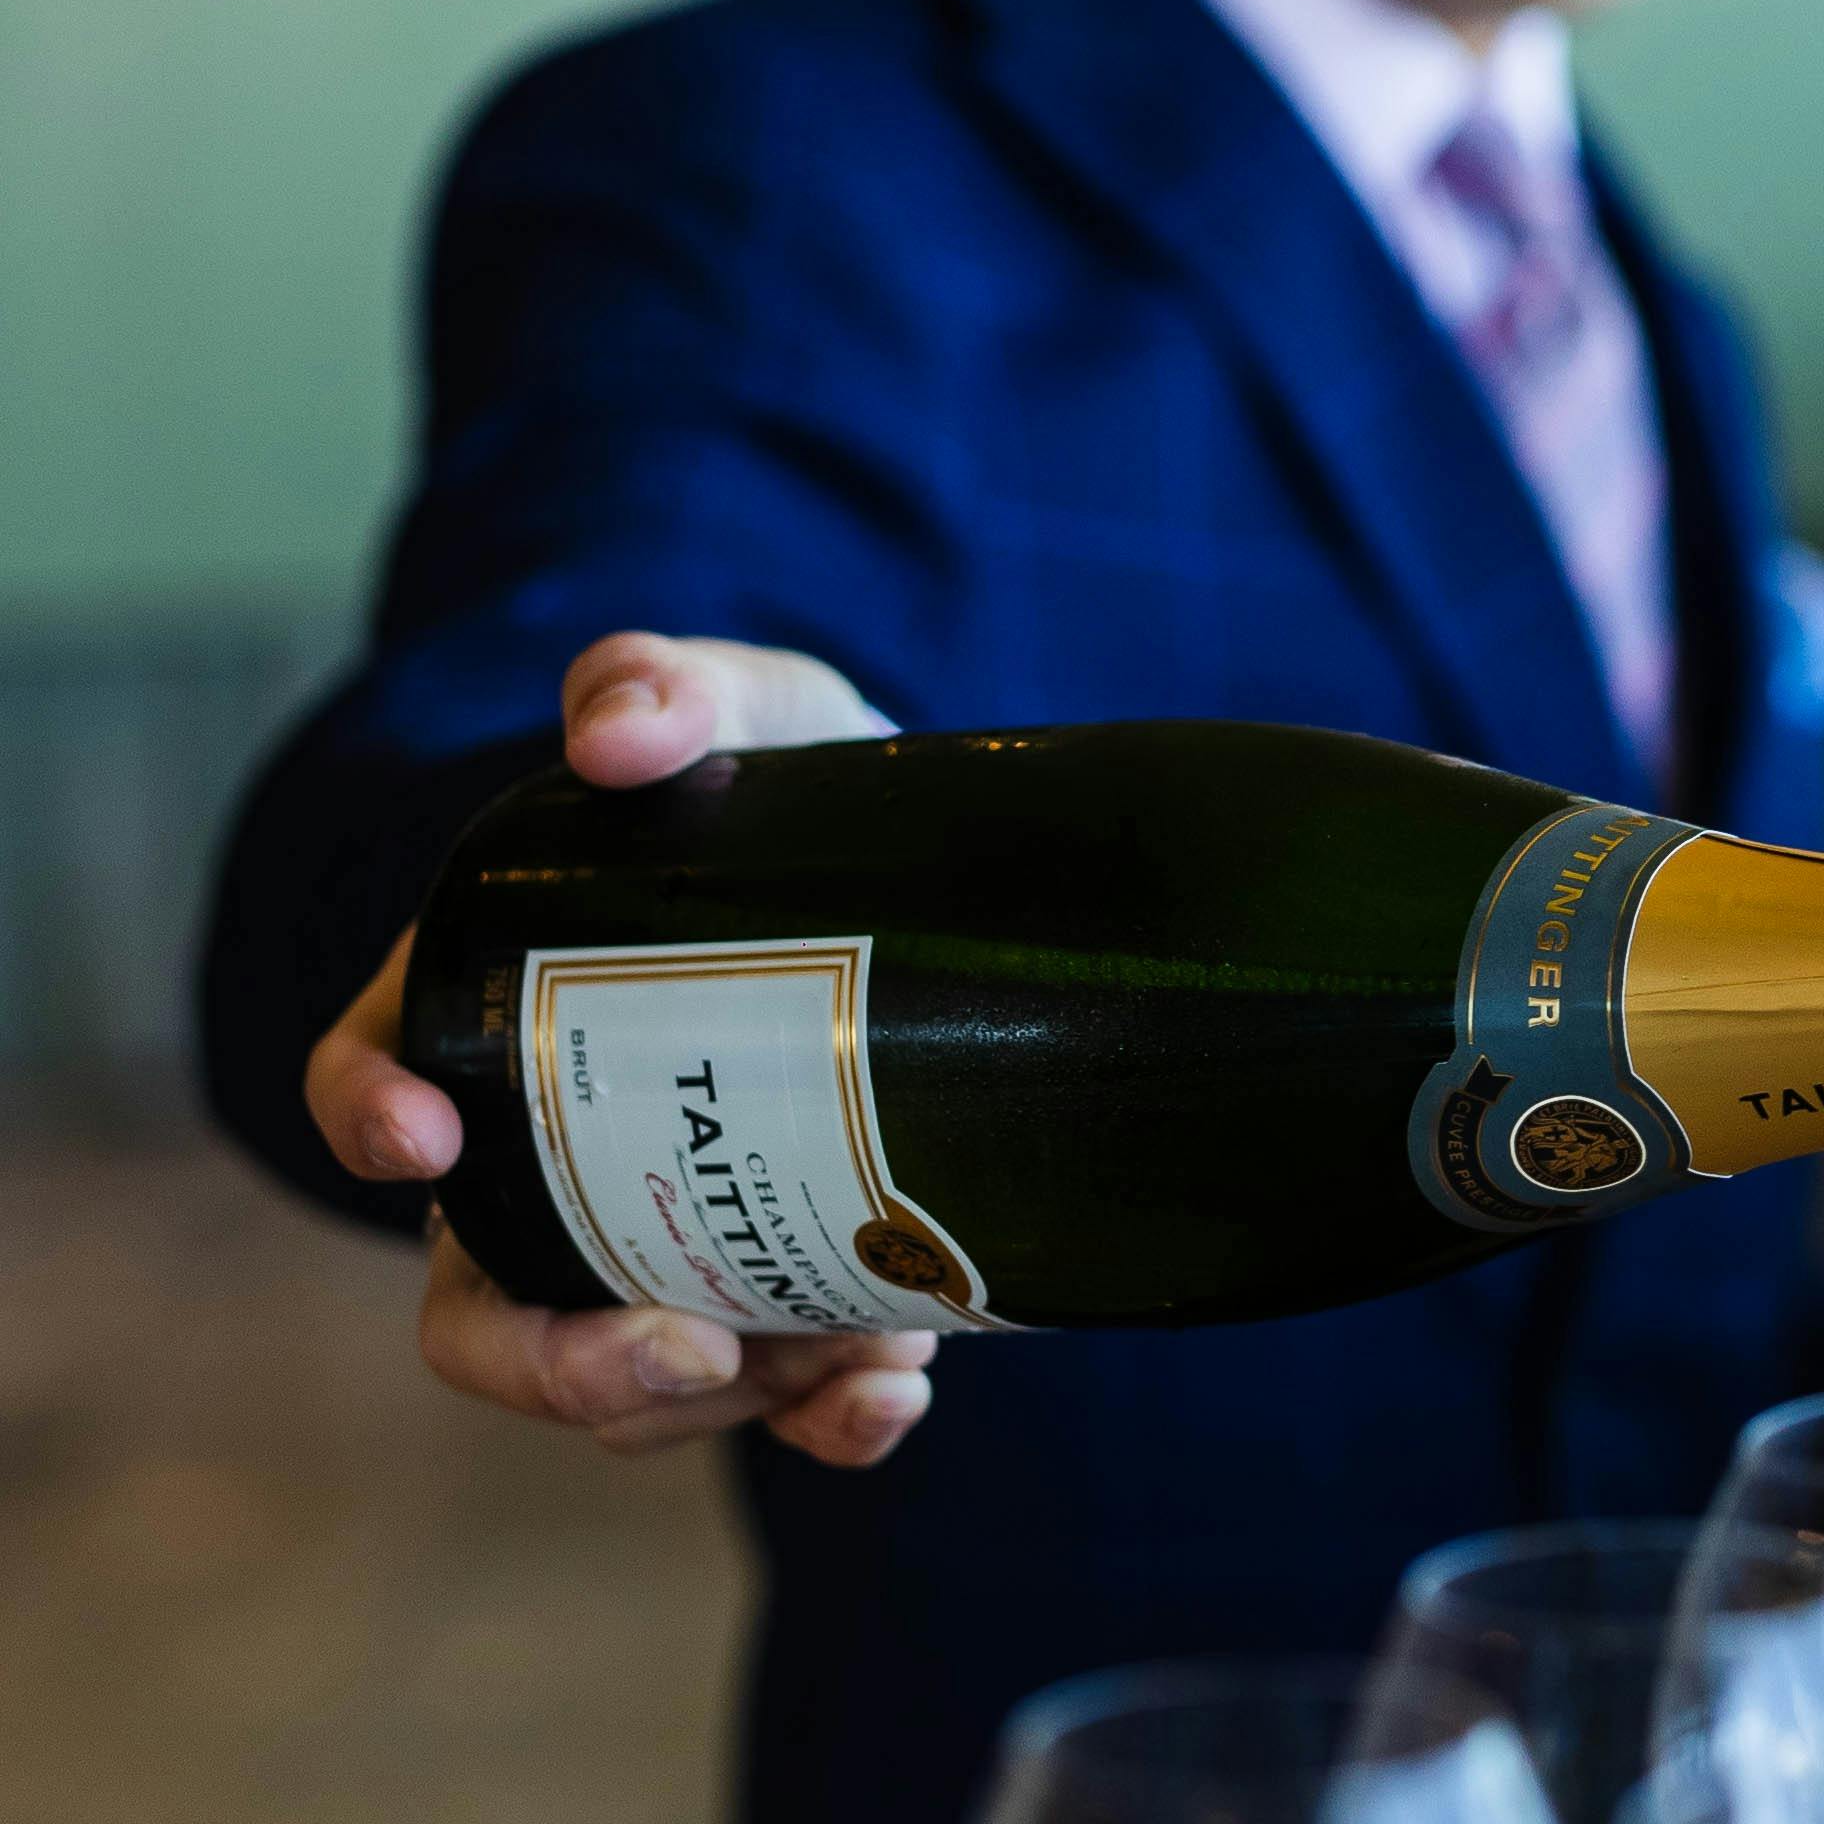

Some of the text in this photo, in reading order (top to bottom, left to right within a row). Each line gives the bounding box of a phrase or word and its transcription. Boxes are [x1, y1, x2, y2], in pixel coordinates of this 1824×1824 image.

[1527, 813, 1652, 1029] AITTINGER
[571, 1028, 593, 1106] BRUT
[1446, 1099, 1472, 1162] CUVÉE
[675, 1059, 858, 1328] TAITTING
